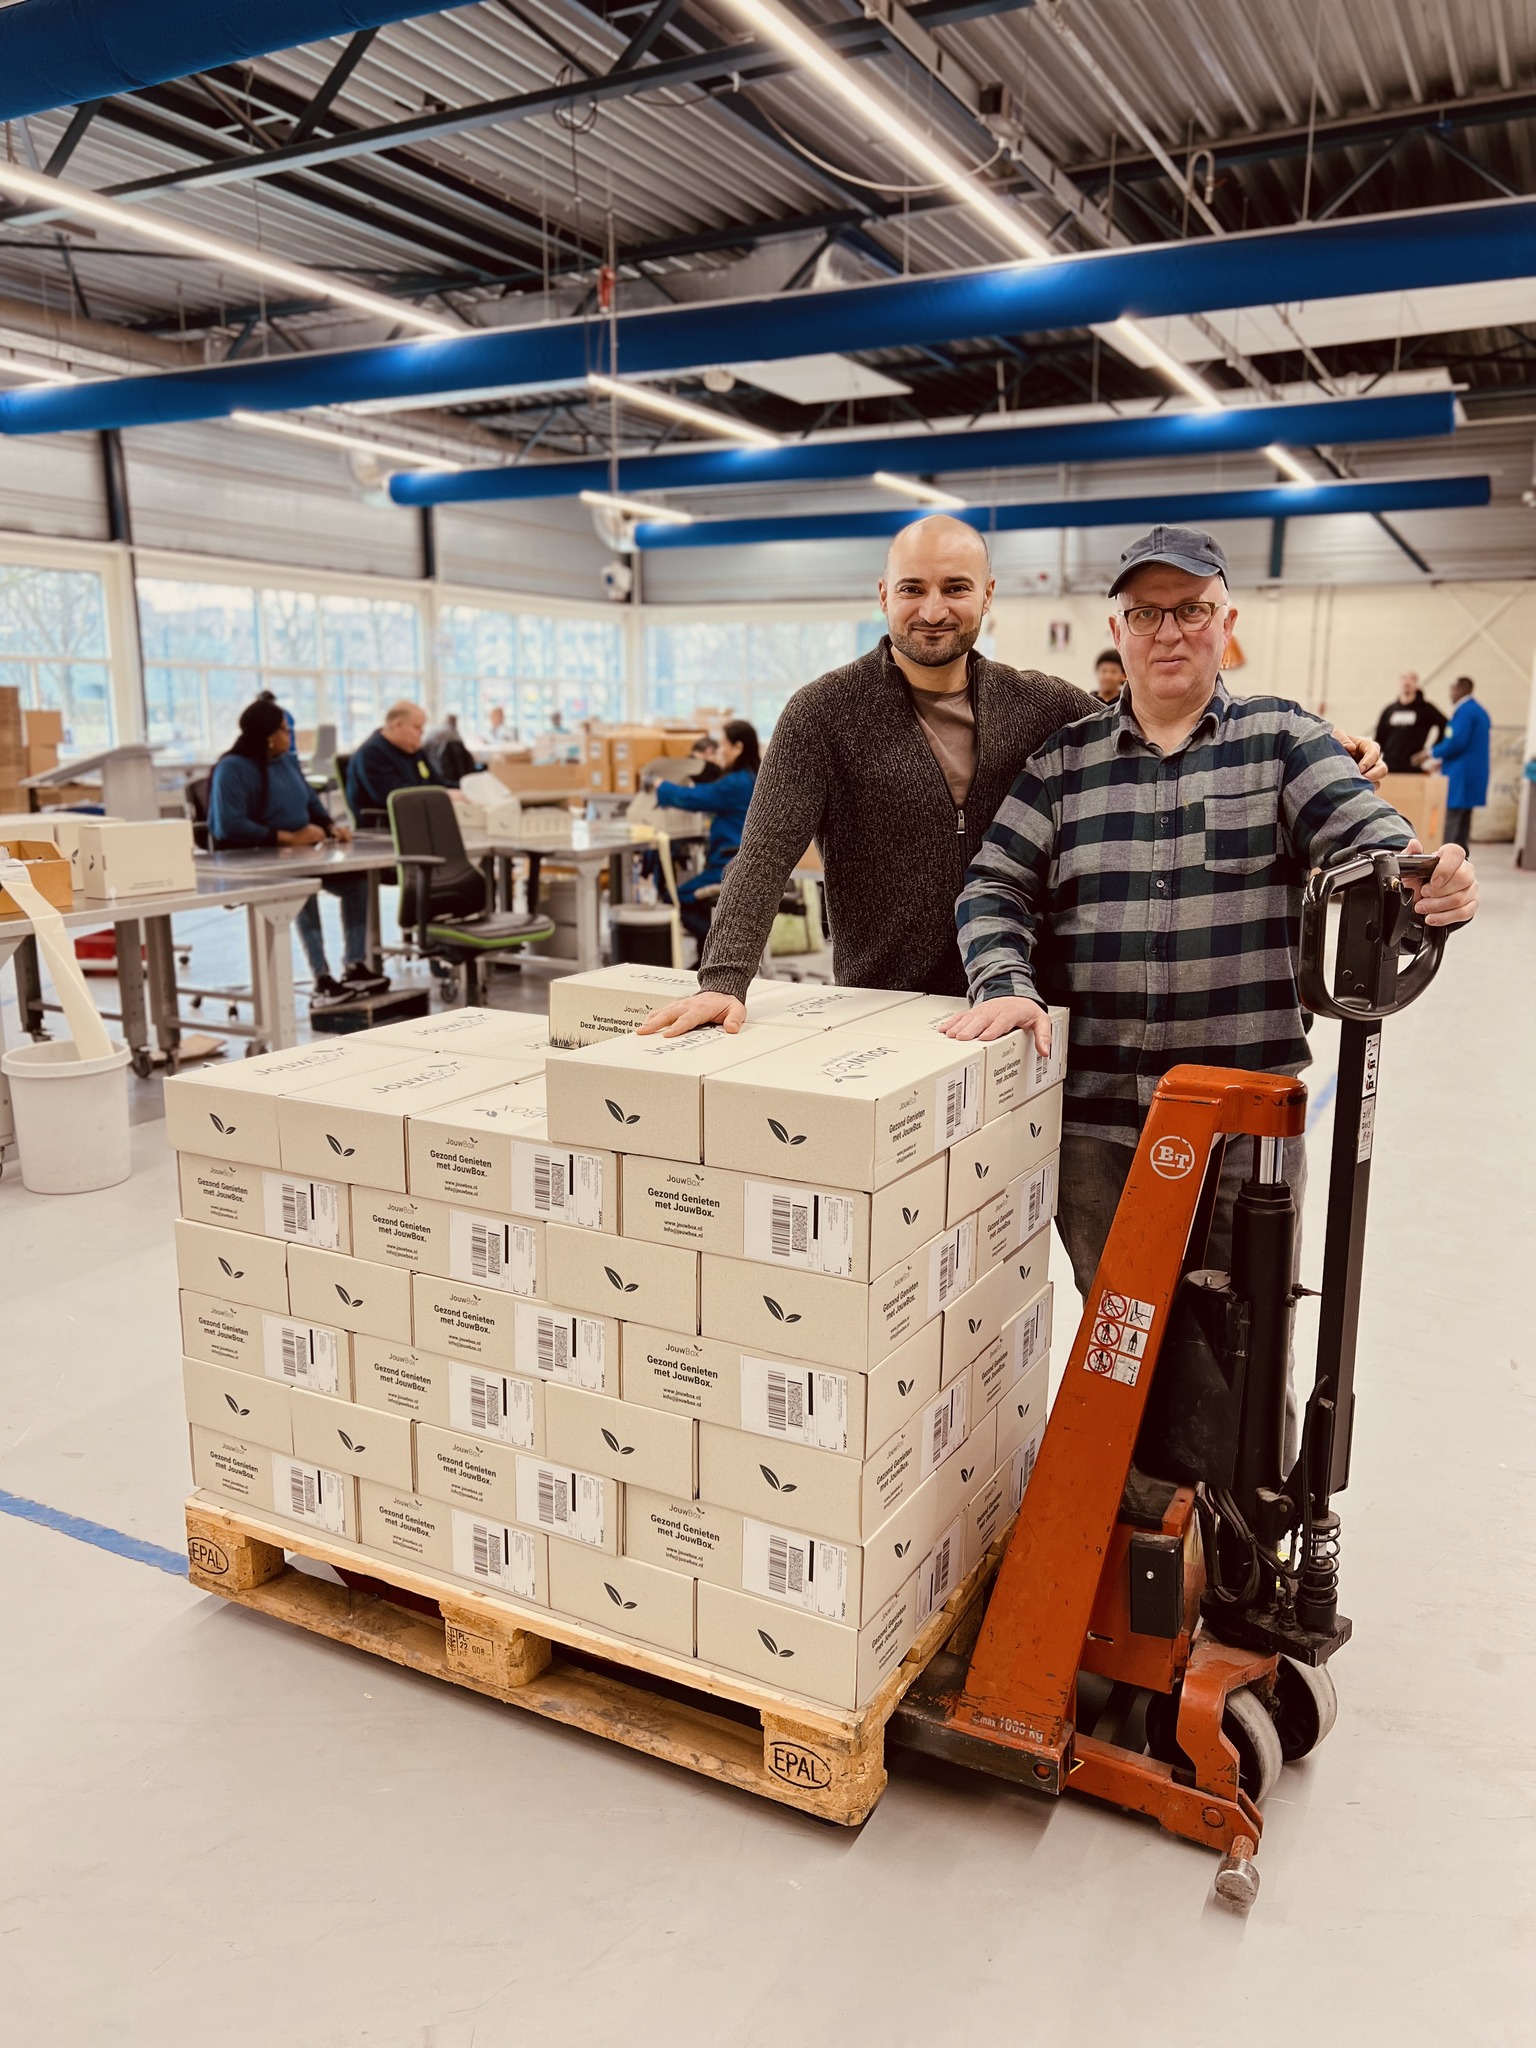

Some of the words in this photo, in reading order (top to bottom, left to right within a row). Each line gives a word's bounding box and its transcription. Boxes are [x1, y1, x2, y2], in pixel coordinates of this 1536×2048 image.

[593, 1015, 633, 1026] Verantwoord
[597, 1024, 626, 1034] JouwBox
[446, 1138, 475, 1148] JouwBox
[430, 1150, 457, 1162] Gezond
[459, 1155, 492, 1168] Genieten
[1158, 1145, 1189, 1169] BT
[437, 1162, 450, 1170] met
[452, 1164, 487, 1177] JouwBox.
[198, 1177, 220, 1189] Gezond
[221, 1183, 248, 1195] Genieten
[666, 1174, 700, 1187] JouwBox
[203, 1188, 215, 1196] met
[216, 1190, 245, 1203] JouwBox.
[647, 1188, 679, 1201] Gezond
[681, 1193, 720, 1208] Genieten
[387, 1203, 415, 1215] JouwBox
[655, 1200, 671, 1211] met
[673, 1204, 714, 1218] JouwBox.
[372, 1215, 398, 1226] Gezond
[400, 1221, 431, 1234] Genieten
[379, 1227, 392, 1235] met
[393, 1230, 427, 1242] JouwBox.
[450, 1294, 478, 1306] JouwBox
[434, 1305, 460, 1318] Gezond
[462, 1311, 495, 1326] Genieten
[198, 1317, 220, 1329] Gezond
[222, 1323, 248, 1336] Genieten
[440, 1317, 454, 1326] met
[456, 1320, 490, 1334] JouwBox.
[204, 1328, 216, 1336] met
[217, 1331, 245, 1344] JouwBox.
[388, 1353, 416, 1365] JouwBox
[665, 1344, 699, 1357] JouwBox
[374, 1363, 399, 1376] Gezond
[401, 1370, 431, 1385] Genieten
[647, 1354, 678, 1370] Gezond
[680, 1362, 718, 1379] Genieten
[380, 1374, 393, 1384] met
[394, 1378, 427, 1393] JouwBox.
[654, 1368, 670, 1380] met
[672, 1372, 713, 1388] JouwBox.
[452, 1444, 480, 1457] JouwBox
[210, 1451, 231, 1464] Gezond
[232, 1458, 258, 1472] Genieten
[437, 1453, 463, 1467] Gezond
[464, 1461, 497, 1478] Genieten
[215, 1462, 226, 1471] met
[228, 1465, 255, 1480] JouwBox.
[443, 1465, 457, 1475] met
[458, 1469, 492, 1486] JouwBox.
[379, 1506, 403, 1520] Gezond
[405, 1513, 435, 1530] Genieten
[669, 1504, 701, 1520] JouwBox
[385, 1517, 398, 1528] met
[399, 1521, 431, 1538] JouwBox.
[650, 1514, 681, 1530] Gezond
[682, 1523, 720, 1542] Genieten
[657, 1526, 674, 1539] met
[675, 1531, 714, 1550] JouwBox.
[192, 1542, 224, 1571] EPAL
[1028, 1725, 1044, 1743] kg
[774, 1748, 822, 1784] EPAL
